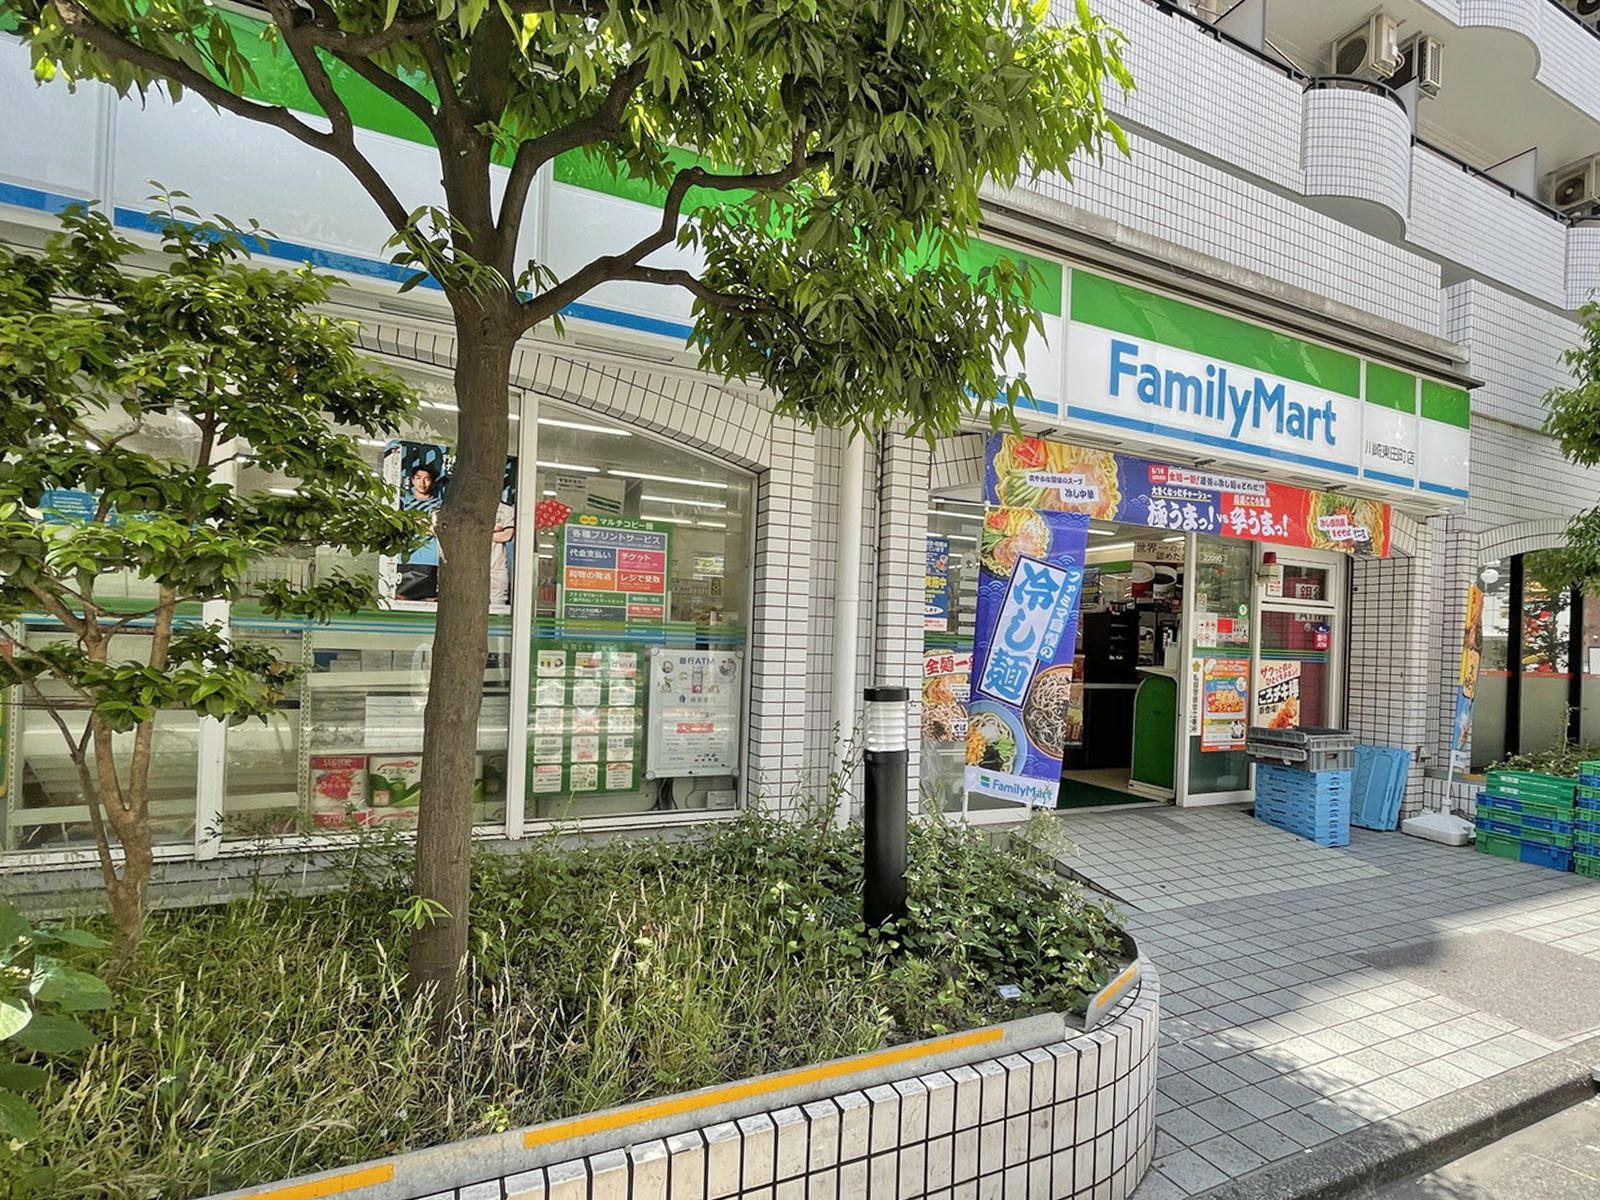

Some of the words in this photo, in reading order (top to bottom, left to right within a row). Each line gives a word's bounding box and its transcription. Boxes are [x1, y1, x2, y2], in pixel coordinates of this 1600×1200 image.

[1110, 339, 1337, 446] FamilyMart
[1365, 440, 1415, 465] 川崎東田町店
[572, 529, 661, 545] 各種プリントサービス
[569, 549, 611, 559] 代金支払い
[621, 552, 651, 561] チケット
[620, 573, 660, 584] レジで受取
[983, 560, 1061, 701] 冷し麺
[991, 778, 1053, 802] FamilyMart
